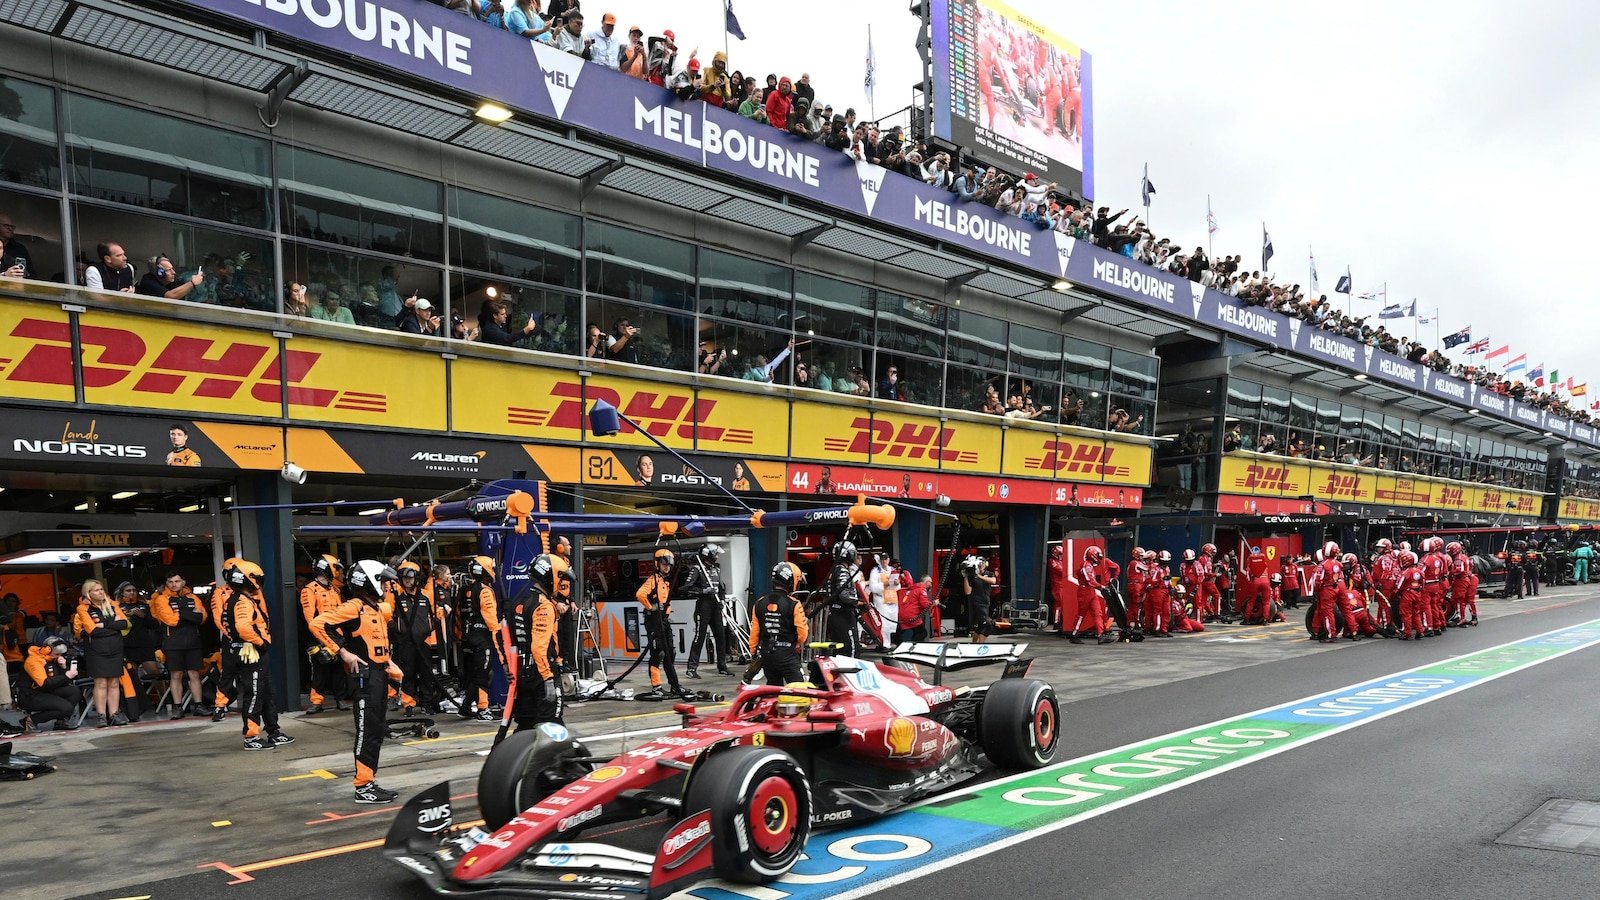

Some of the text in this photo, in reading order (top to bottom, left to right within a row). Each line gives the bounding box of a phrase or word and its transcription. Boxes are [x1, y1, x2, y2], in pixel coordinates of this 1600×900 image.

[541, 67, 574, 90] MEL
[634, 96, 821, 188] MELBOURNE
[859, 173, 880, 194] MEL
[914, 194, 1032, 258] MELBOURNE
[1092, 257, 1176, 304] MELBOURNE
[1217, 301, 1278, 338] MELBOURNE
[1309, 334, 1356, 364] MELBOURNE
[6, 318, 339, 408] DHL
[1379, 358, 1417, 383] MELBOURNE
[1434, 378, 1465, 399] MELBOURNE
[546, 381, 726, 442] DHL
[1480, 393, 1504, 412] MELBOURNE
[61, 419, 99, 445] Lando
[847, 416, 961, 461] DHL
[13, 438, 147, 458] NORRIS
[234, 444, 272, 452] McLaren
[409, 451, 479, 464] McLaren
[1040, 440, 1118, 476] DHL
[588, 455, 618, 481] 81
[792, 470, 809, 489] 44
[1244, 464, 1291, 491] DHL
[837, 482, 897, 494] HAMILTON
[1055, 487, 1067, 501] 16
[1325, 474, 1362, 497] DHL
[486, 500, 506, 512] WORLD
[1083, 497, 1115, 505] LECLERC
[813, 509, 848, 520] DP WORLD
[1264, 516, 1292, 524] CEVA
[1292, 677, 1456, 718] aramco
[1002, 724, 1293, 807] aramco
[418, 803, 451, 824] aws
[823, 809, 852, 821] POKER
[673, 820, 711, 850] UniCredit
[576, 876, 641, 886] V-Power
